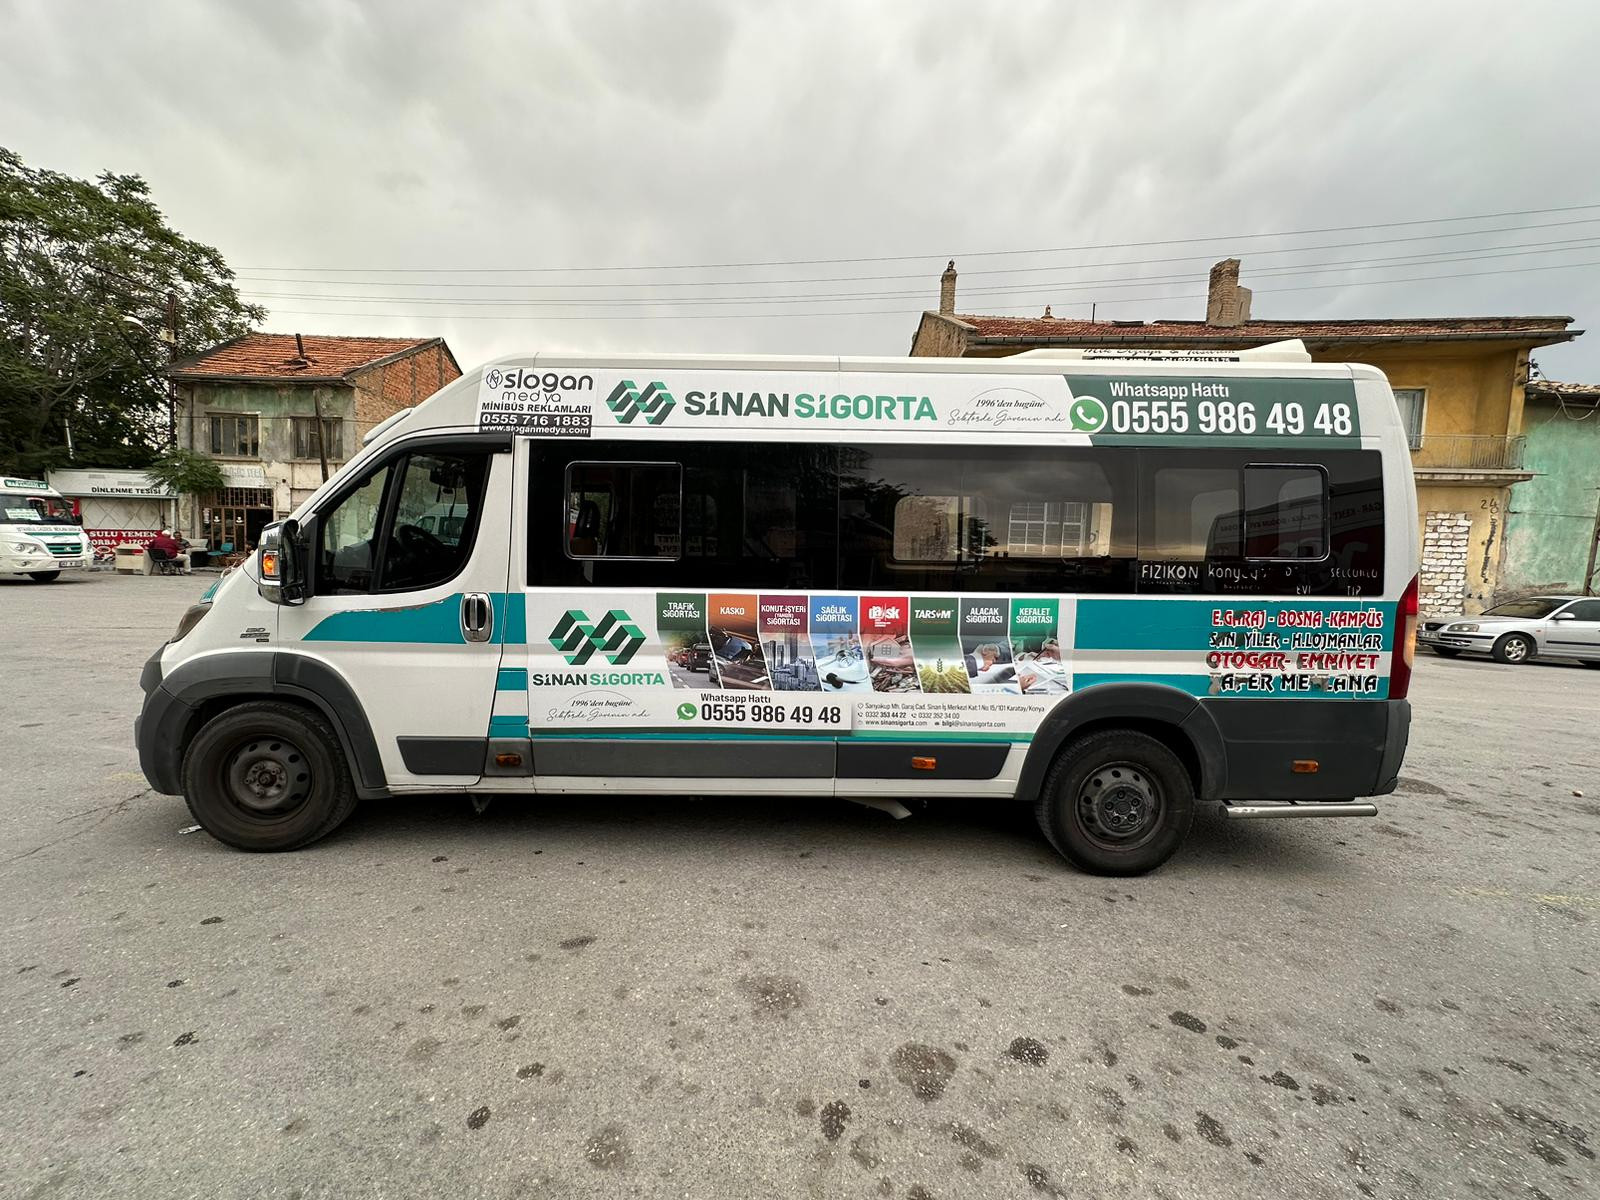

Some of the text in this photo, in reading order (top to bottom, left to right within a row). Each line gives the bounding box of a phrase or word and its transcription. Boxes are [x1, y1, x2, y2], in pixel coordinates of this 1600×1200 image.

[504, 369, 594, 393] slogan
[502, 390, 562, 404] medya
[1110, 382, 1229, 400] Whatsapp Hattı
[481, 401, 592, 414] MİNİBÜS REKLAMLARI
[1014, 400, 1046, 410] bugüne
[482, 414, 590, 426] 0555 716 1883
[1111, 401, 1352, 436] 0555 986 49 48
[481, 425, 589, 434] www.sloganmedya.com
[120, 530, 158, 538] YEMEK
[720, 606, 745, 616] KASKO
[821, 604, 846, 614] SAĞLIK
[970, 608, 999, 616] ALACAK
[1019, 608, 1050, 616] KEFALET
[1277, 610, 1322, 628] BOSNA
[1296, 650, 1380, 670] EMNİYET
[1280, 673, 1378, 694] MEANA
[700, 693, 771, 704] Whatsapp Hattı
[701, 704, 841, 724] 0555 986 49 48
